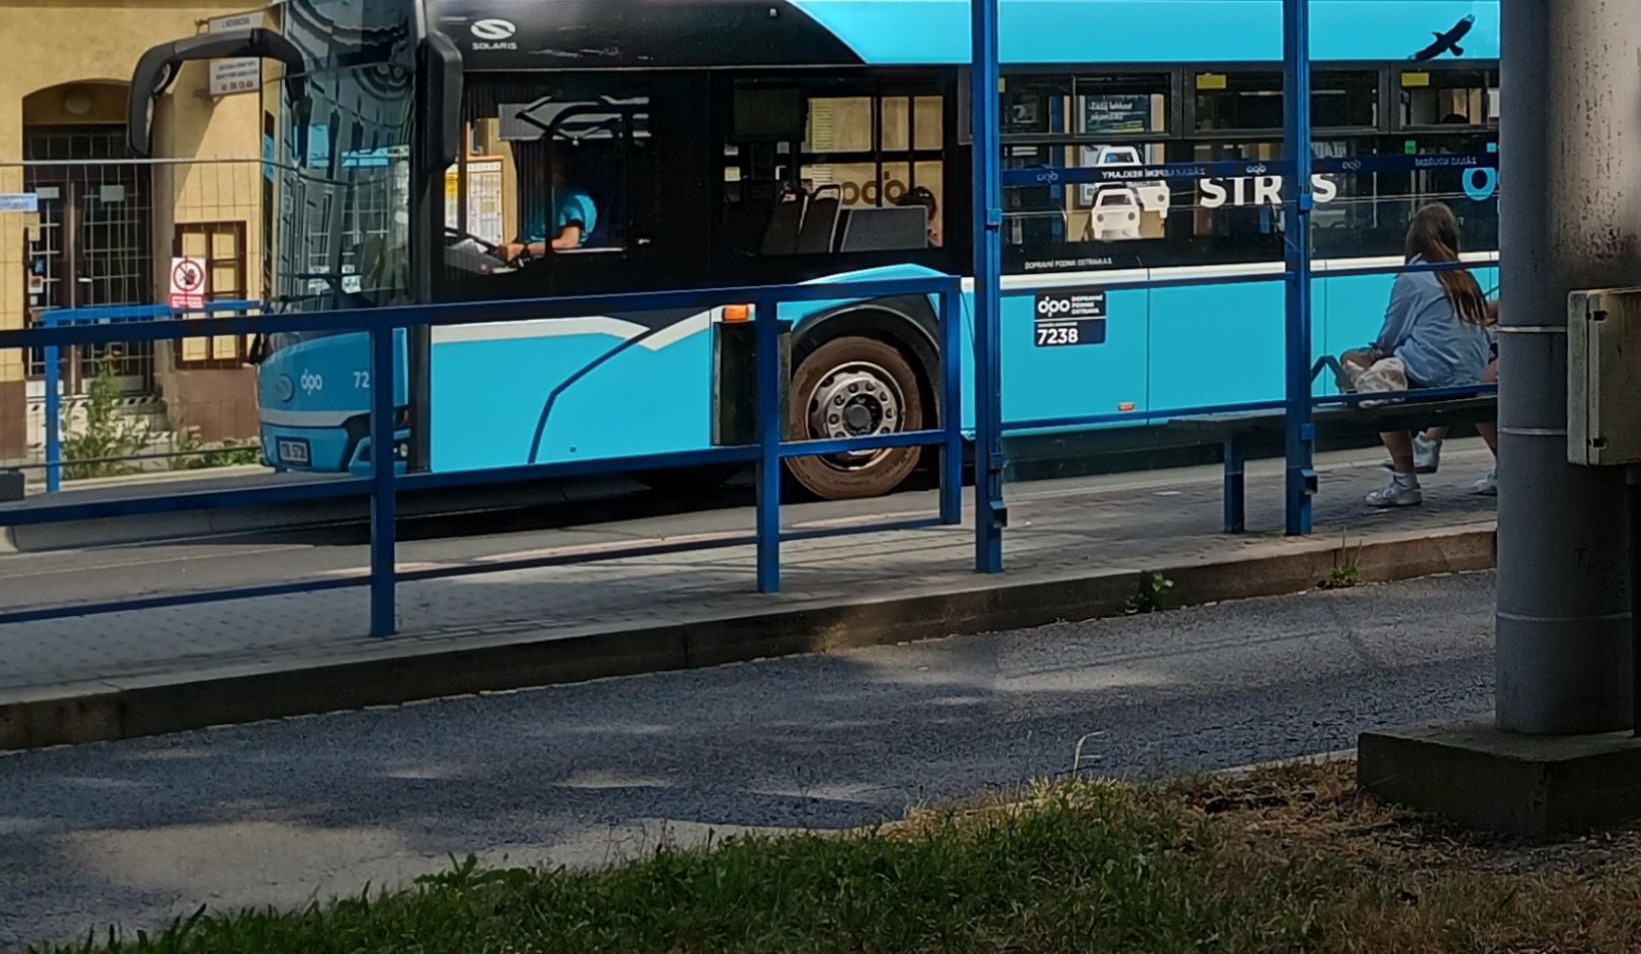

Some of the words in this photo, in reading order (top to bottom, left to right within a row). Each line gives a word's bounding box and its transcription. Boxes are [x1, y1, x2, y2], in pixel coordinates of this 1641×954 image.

[472, 42, 518, 51] SOLARIS
[1200, 173, 1337, 208] STRS
[1037, 328, 1079, 345] 7238
